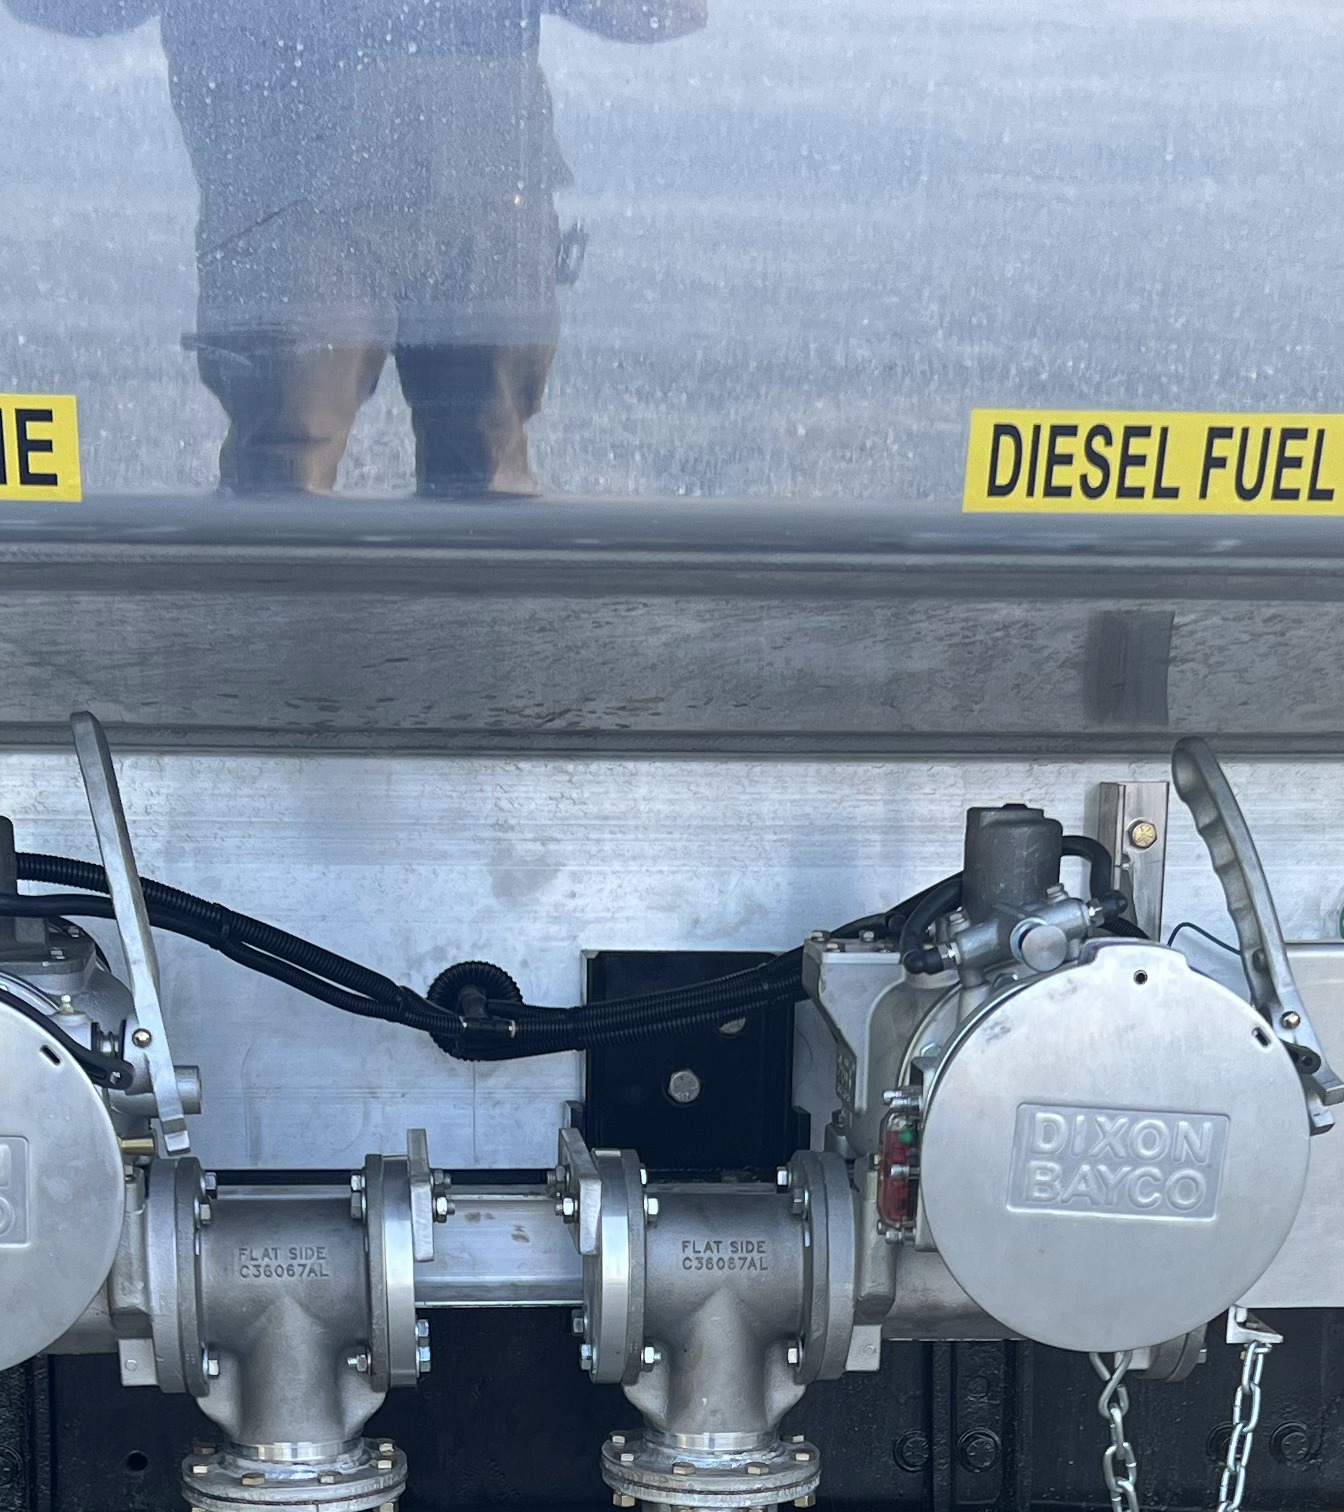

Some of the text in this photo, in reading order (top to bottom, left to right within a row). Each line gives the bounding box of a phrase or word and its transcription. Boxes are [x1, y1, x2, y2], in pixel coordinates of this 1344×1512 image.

[987, 422, 1335, 502] DIESEL FUEL
[1032, 1111, 1212, 1165] DIXON
[1027, 1161, 1208, 1211] BAYCO
[238, 1246, 327, 1261] FLAT SIDE
[681, 1240, 766, 1254] FLAT SIDE
[239, 1263, 330, 1278] C36067AL
